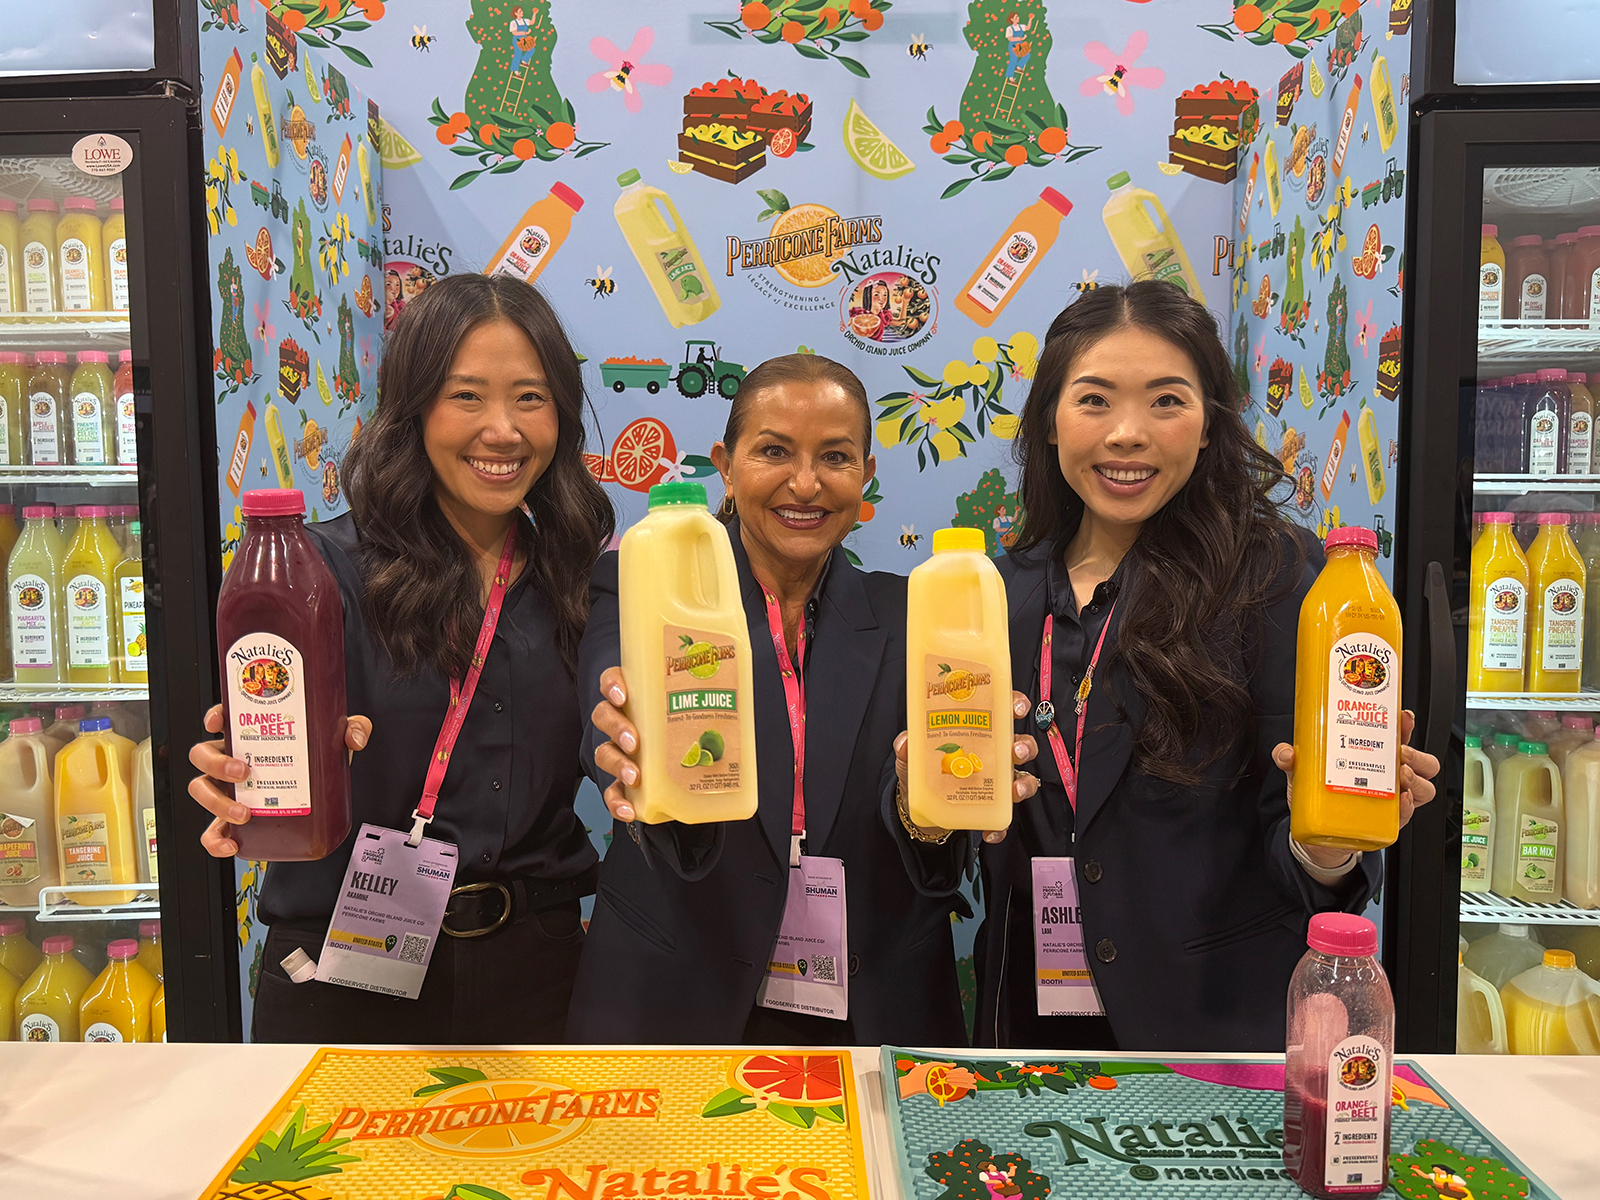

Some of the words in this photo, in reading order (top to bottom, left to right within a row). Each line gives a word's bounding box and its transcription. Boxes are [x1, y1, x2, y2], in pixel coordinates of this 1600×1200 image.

[84, 148, 121, 160] LOWE
[726, 227, 824, 276] PERRICONE
[825, 216, 882, 257] FARMS
[747, 274, 772, 299] LEGACY
[783, 301, 836, 311] EXCELLENCE
[758, 273, 819, 302] STRENGTHENING
[844, 331, 866, 351] ORCHID
[866, 344, 887, 356] ISLAND
[888, 346, 907, 356] JUICE
[908, 331, 933, 352] COMPANY
[1490, 625, 1518, 633] PINEAPPLE
[666, 651, 710, 676] PERRICONE
[710, 645, 736, 665] FARMS
[926, 677, 966, 699] PERRICONE
[966, 673, 991, 691] FARMS
[672, 693, 699, 710] LIME
[701, 693, 733, 707] JUICE
[1337, 699, 1377, 712] ORANGE
[239, 713, 282, 726] ORANGE
[931, 714, 960, 726] LEMON
[963, 714, 988, 726] JUICE
[1353, 711, 1388, 725] JUICE
[260, 721, 295, 736] BEET
[1340, 737, 1346, 748] 1
[1348, 737, 1384, 749] INGREDIENT
[1470, 836, 1486, 844] JUICE
[5, 850, 21, 858] JUICE
[69, 846, 102, 855] TANGERINE
[1523, 846, 1538, 855] BAR
[1540, 846, 1553, 856] MIX
[77, 854, 94, 862] JUICE
[417, 866, 451, 879] SHUMAN
[350, 870, 399, 896] KELLEY
[346, 891, 369, 901] AKAMINE
[805, 887, 838, 895] SHUMAN
[342, 911, 369, 921] PERRICONE
[369, 916, 385, 924] FARMS
[343, 905, 367, 914] NATALIE'S
[367, 910, 386, 918] ORCHID
[385, 914, 403, 922] ISLAND
[329, 941, 352, 951] BOOTH
[352, 936, 367, 945] UNITED
[367, 939, 383, 948] STATES
[328, 976, 368, 989] FOODSERVICE
[369, 983, 407, 996] DISTRIBUTOR
[765, 999, 800, 1009] FOODSERVICE
[800, 1004, 835, 1014] DISTRIBUTOR
[1335, 1100, 1369, 1112] ORANGE
[1351, 1106, 1378, 1118] BEET
[319, 1098, 548, 1142] PERRICONE
[538, 1089, 660, 1125] FARMS
[1334, 1134, 1340, 1145] 2
